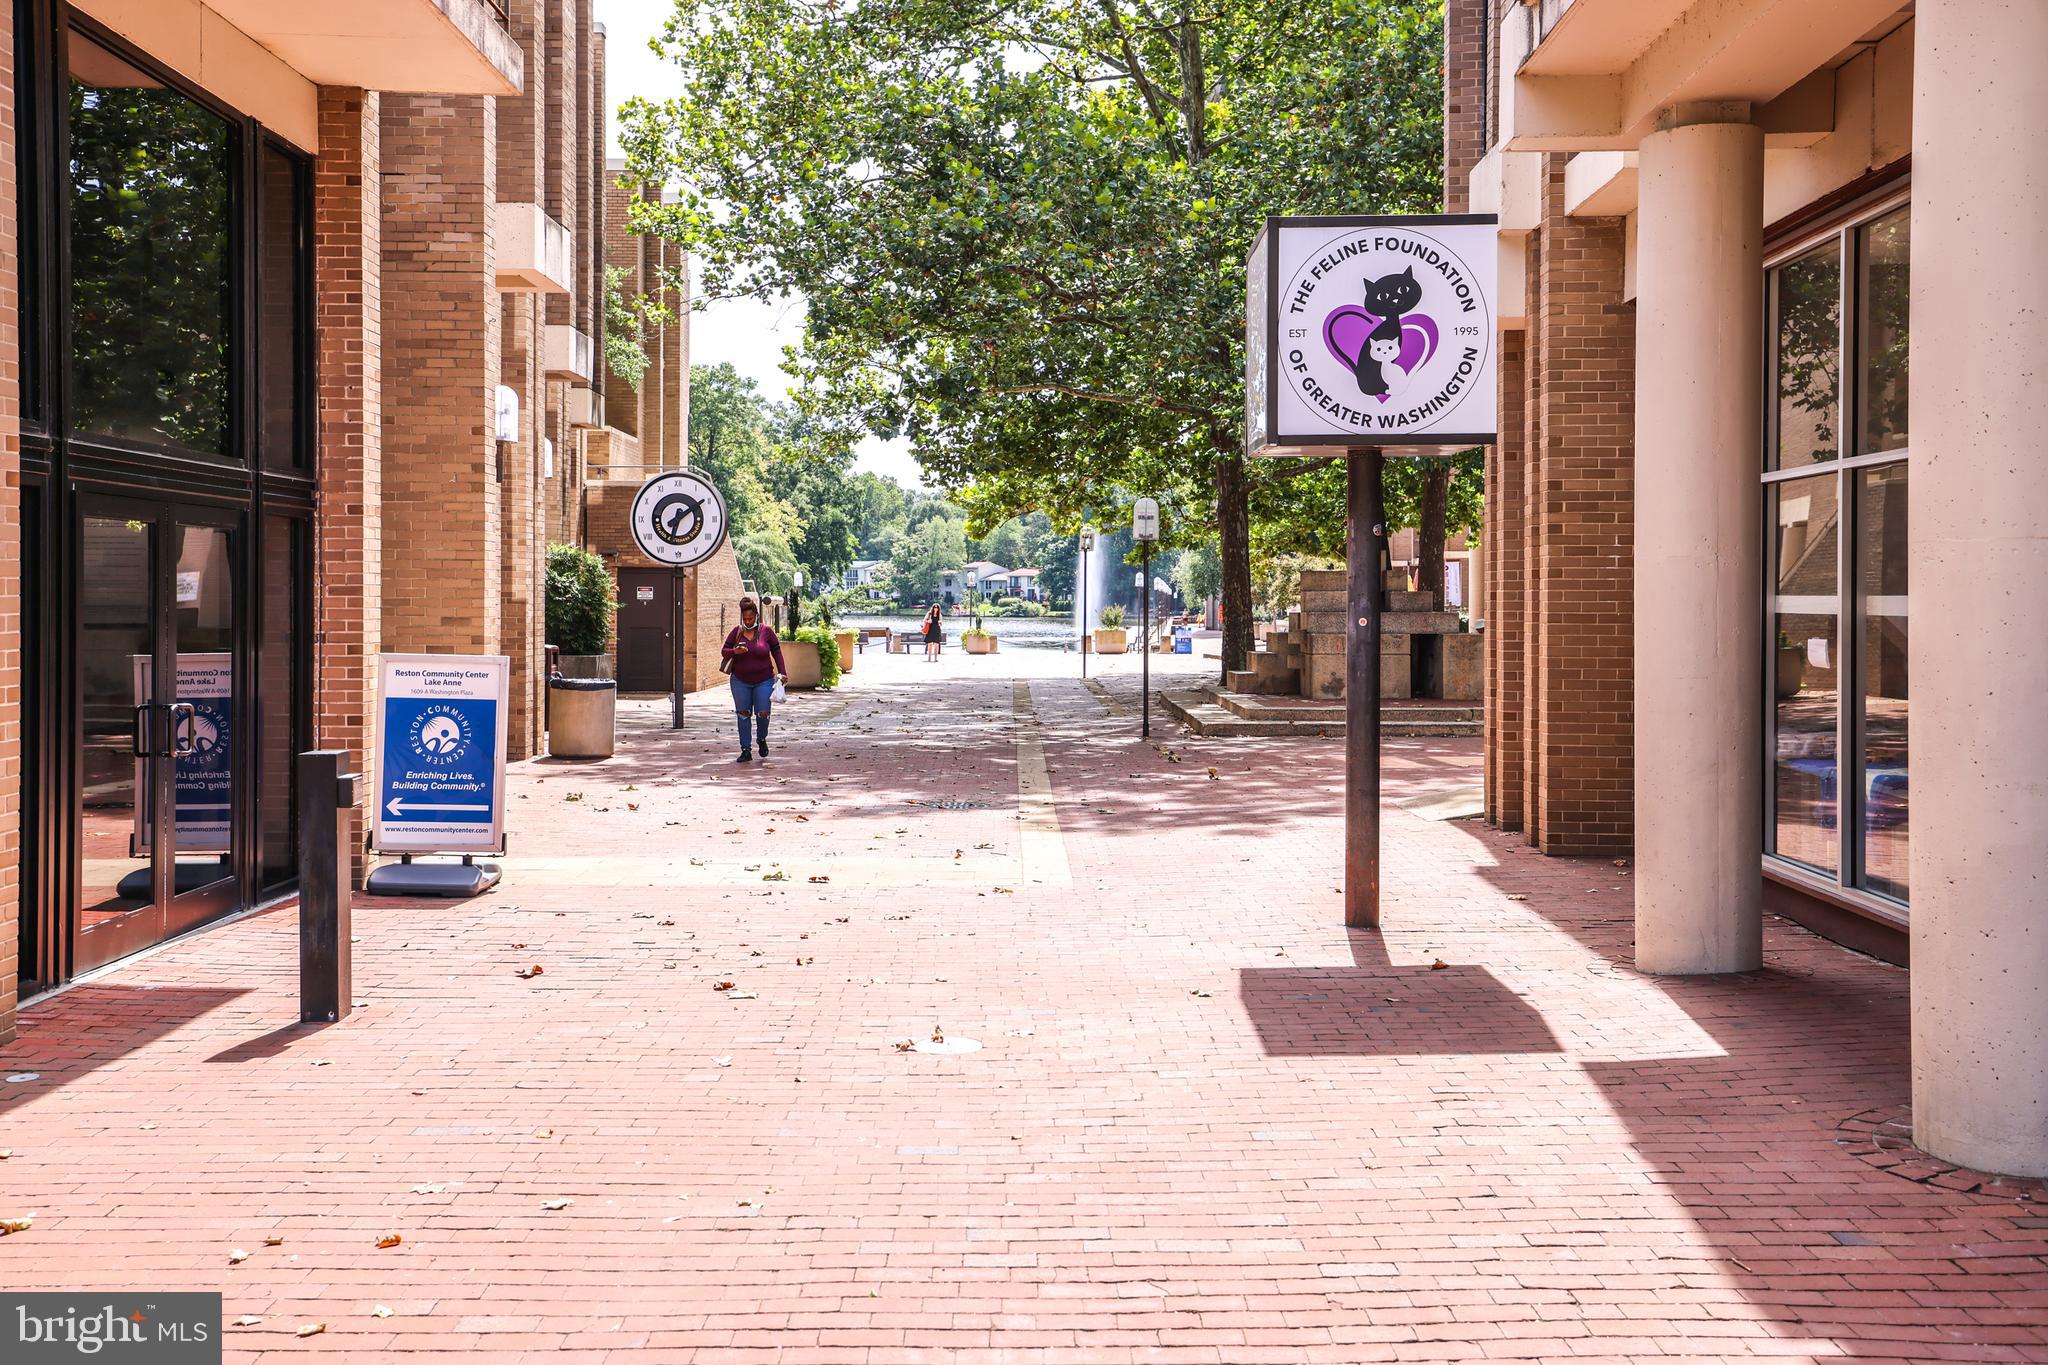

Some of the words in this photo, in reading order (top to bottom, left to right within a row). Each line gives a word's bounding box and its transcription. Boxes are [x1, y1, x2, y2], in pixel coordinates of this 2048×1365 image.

[1290, 279, 1316, 314] THE
[1310, 239, 1369, 280] FELINE
[1374, 237, 1477, 313] FOUNDATION
[1288, 329, 1307, 338] EST
[1454, 326, 1479, 336] 1995
[1289, 349, 1308, 374] OF
[1302, 376, 1373, 428] GREATER
[1377, 346, 1479, 429] WASHINGTON
[395, 669, 421, 677] Reston
[421, 670, 464, 679] Community
[465, 671, 489, 679] Center
[429, 689, 460, 697] Washington
[427, 705, 472, 745] COMMUNITY
[409, 715, 424, 754] RESTON
[426, 749, 465, 765] CENTER
[406, 771, 448, 780] Enriching
[449, 772, 475, 780] Lives.
[392, 781, 428, 791] Building
[384, 826, 489, 834] www.restoncommunitycenter.com
